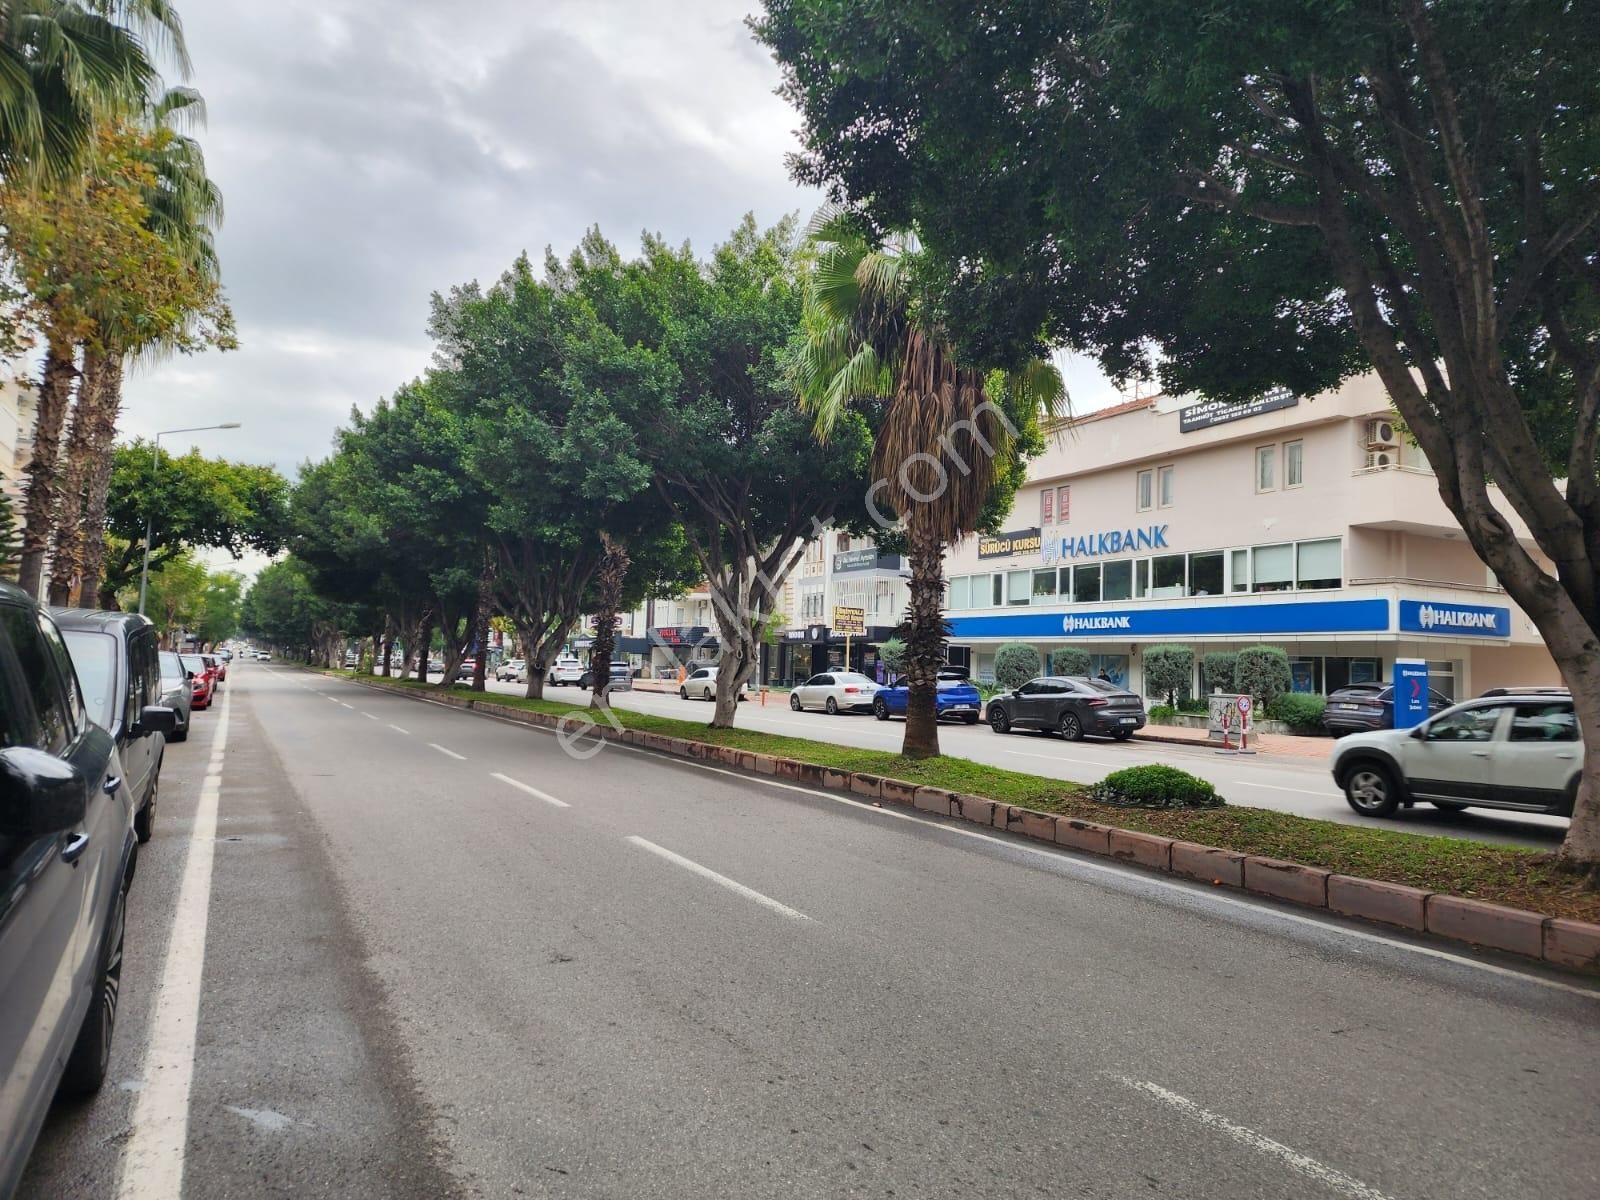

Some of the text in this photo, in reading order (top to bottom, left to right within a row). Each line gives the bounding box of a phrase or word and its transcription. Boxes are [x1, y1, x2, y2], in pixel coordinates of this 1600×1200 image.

[1012, 536, 1040, 551] KURSU
[1062, 525, 1168, 558] HALKBANK
[1074, 616, 1130, 630] HALKBANK
[1434, 610, 1496, 628] HALKBANK
